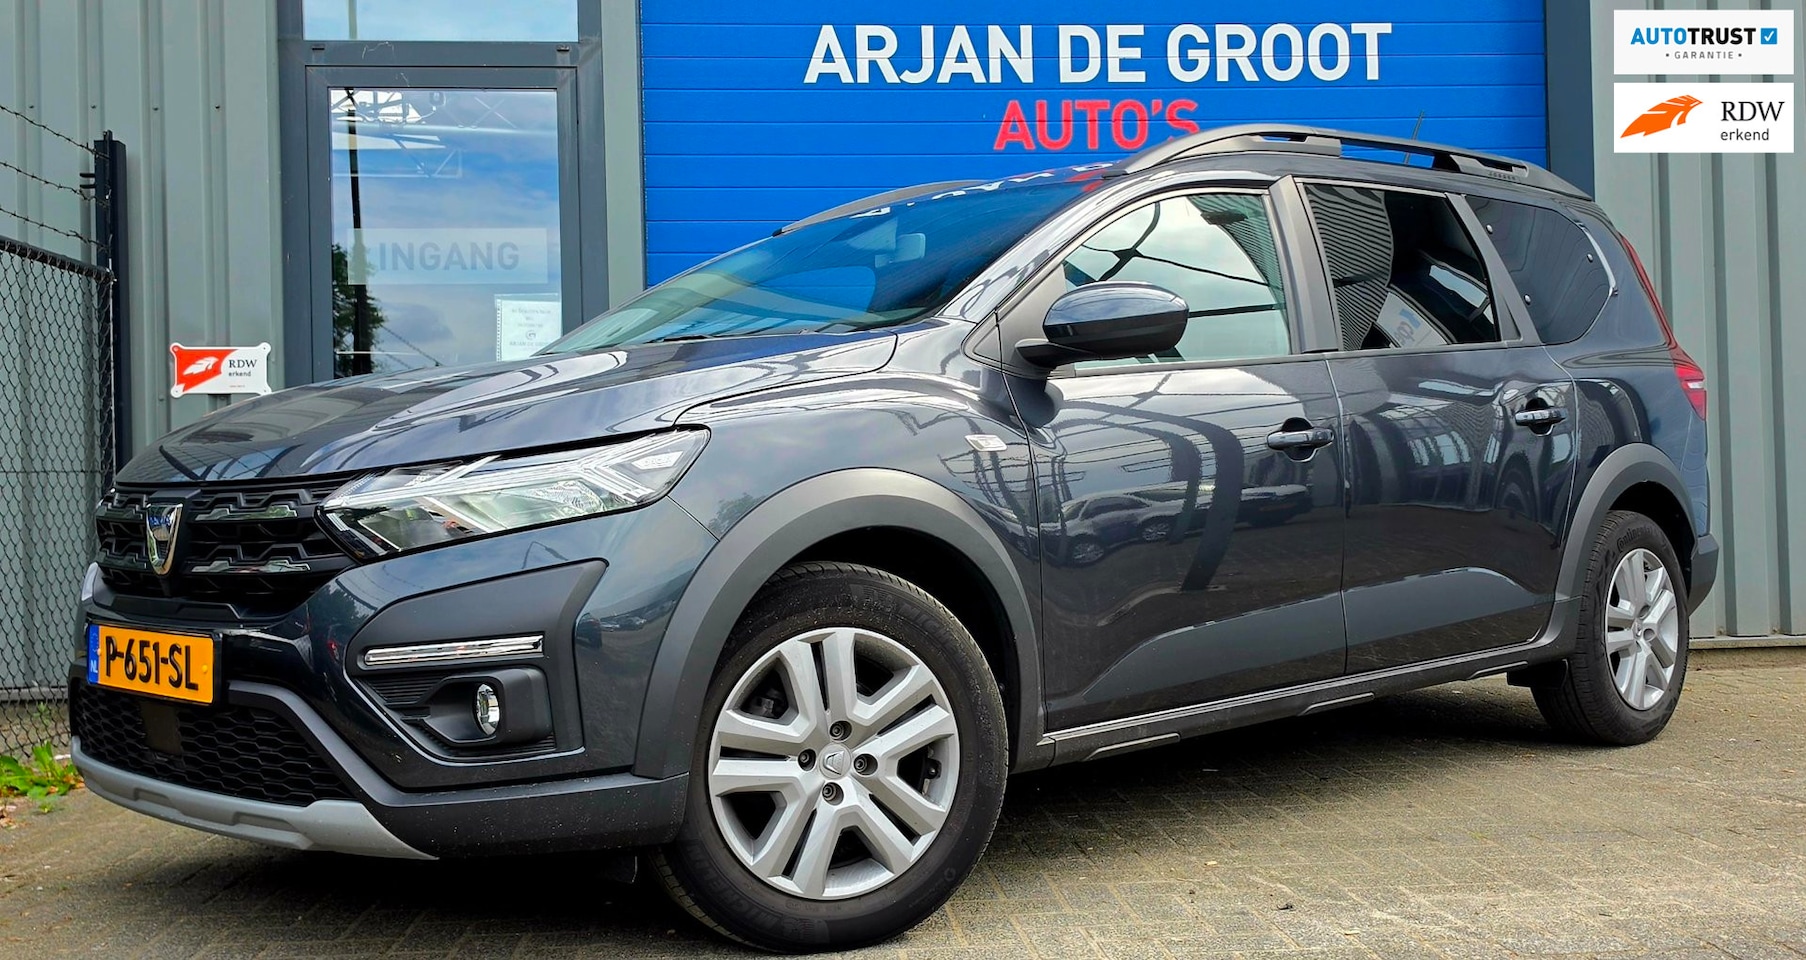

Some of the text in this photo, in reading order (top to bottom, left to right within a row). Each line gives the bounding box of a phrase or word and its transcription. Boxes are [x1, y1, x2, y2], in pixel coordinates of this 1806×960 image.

[803, 22, 1393, 84] ARJAN DE GROOT
[993, 98, 1199, 150] AUTO'S
[379, 241, 519, 271] INGANG
[228, 359, 257, 369] RDW
[90, 659, 98, 673] NL
[105, 635, 199, 691] P-651-SL
